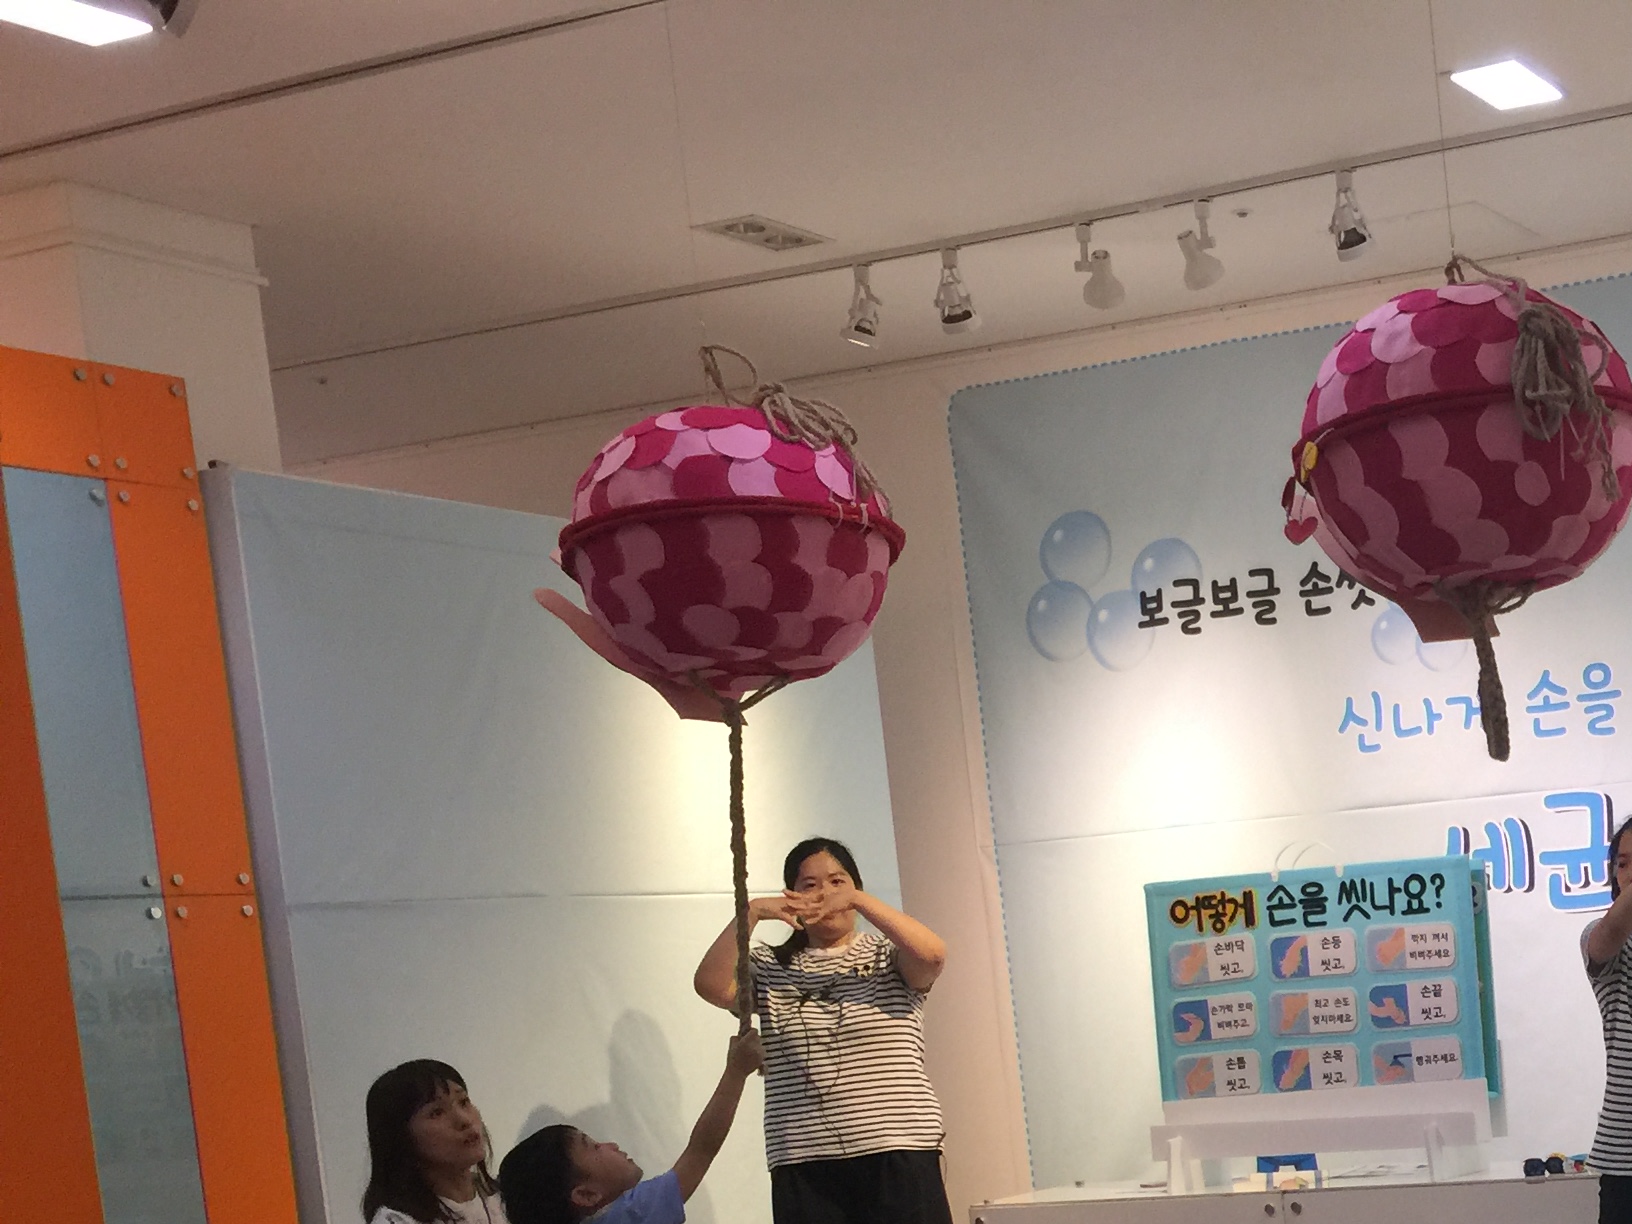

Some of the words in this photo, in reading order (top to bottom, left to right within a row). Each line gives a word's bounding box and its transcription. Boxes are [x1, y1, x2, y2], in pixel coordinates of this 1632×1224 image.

[1137, 567, 1281, 636] 보글보글
[1525, 660, 1623, 739] 손을
[1170, 889, 1256, 934] 어떻게
[1266, 881, 1329, 928] 손을
[1338, 873, 1446, 924] 씻나요?
[1213, 938, 1246, 956] 손바닥
[1320, 935, 1342, 950] 손등
[1219, 961, 1244, 977] 씻고,
[1320, 956, 1346, 972] 씻고,
[1420, 984, 1443, 999] 손끝
[1420, 1005, 1447, 1021] 씻고,
[1225, 1056, 1247, 1071] 손톱
[1321, 1049, 1344, 1063] 손목
[1226, 1077, 1251, 1092] 씻고,
[1322, 1071, 1346, 1086] 씻고,
